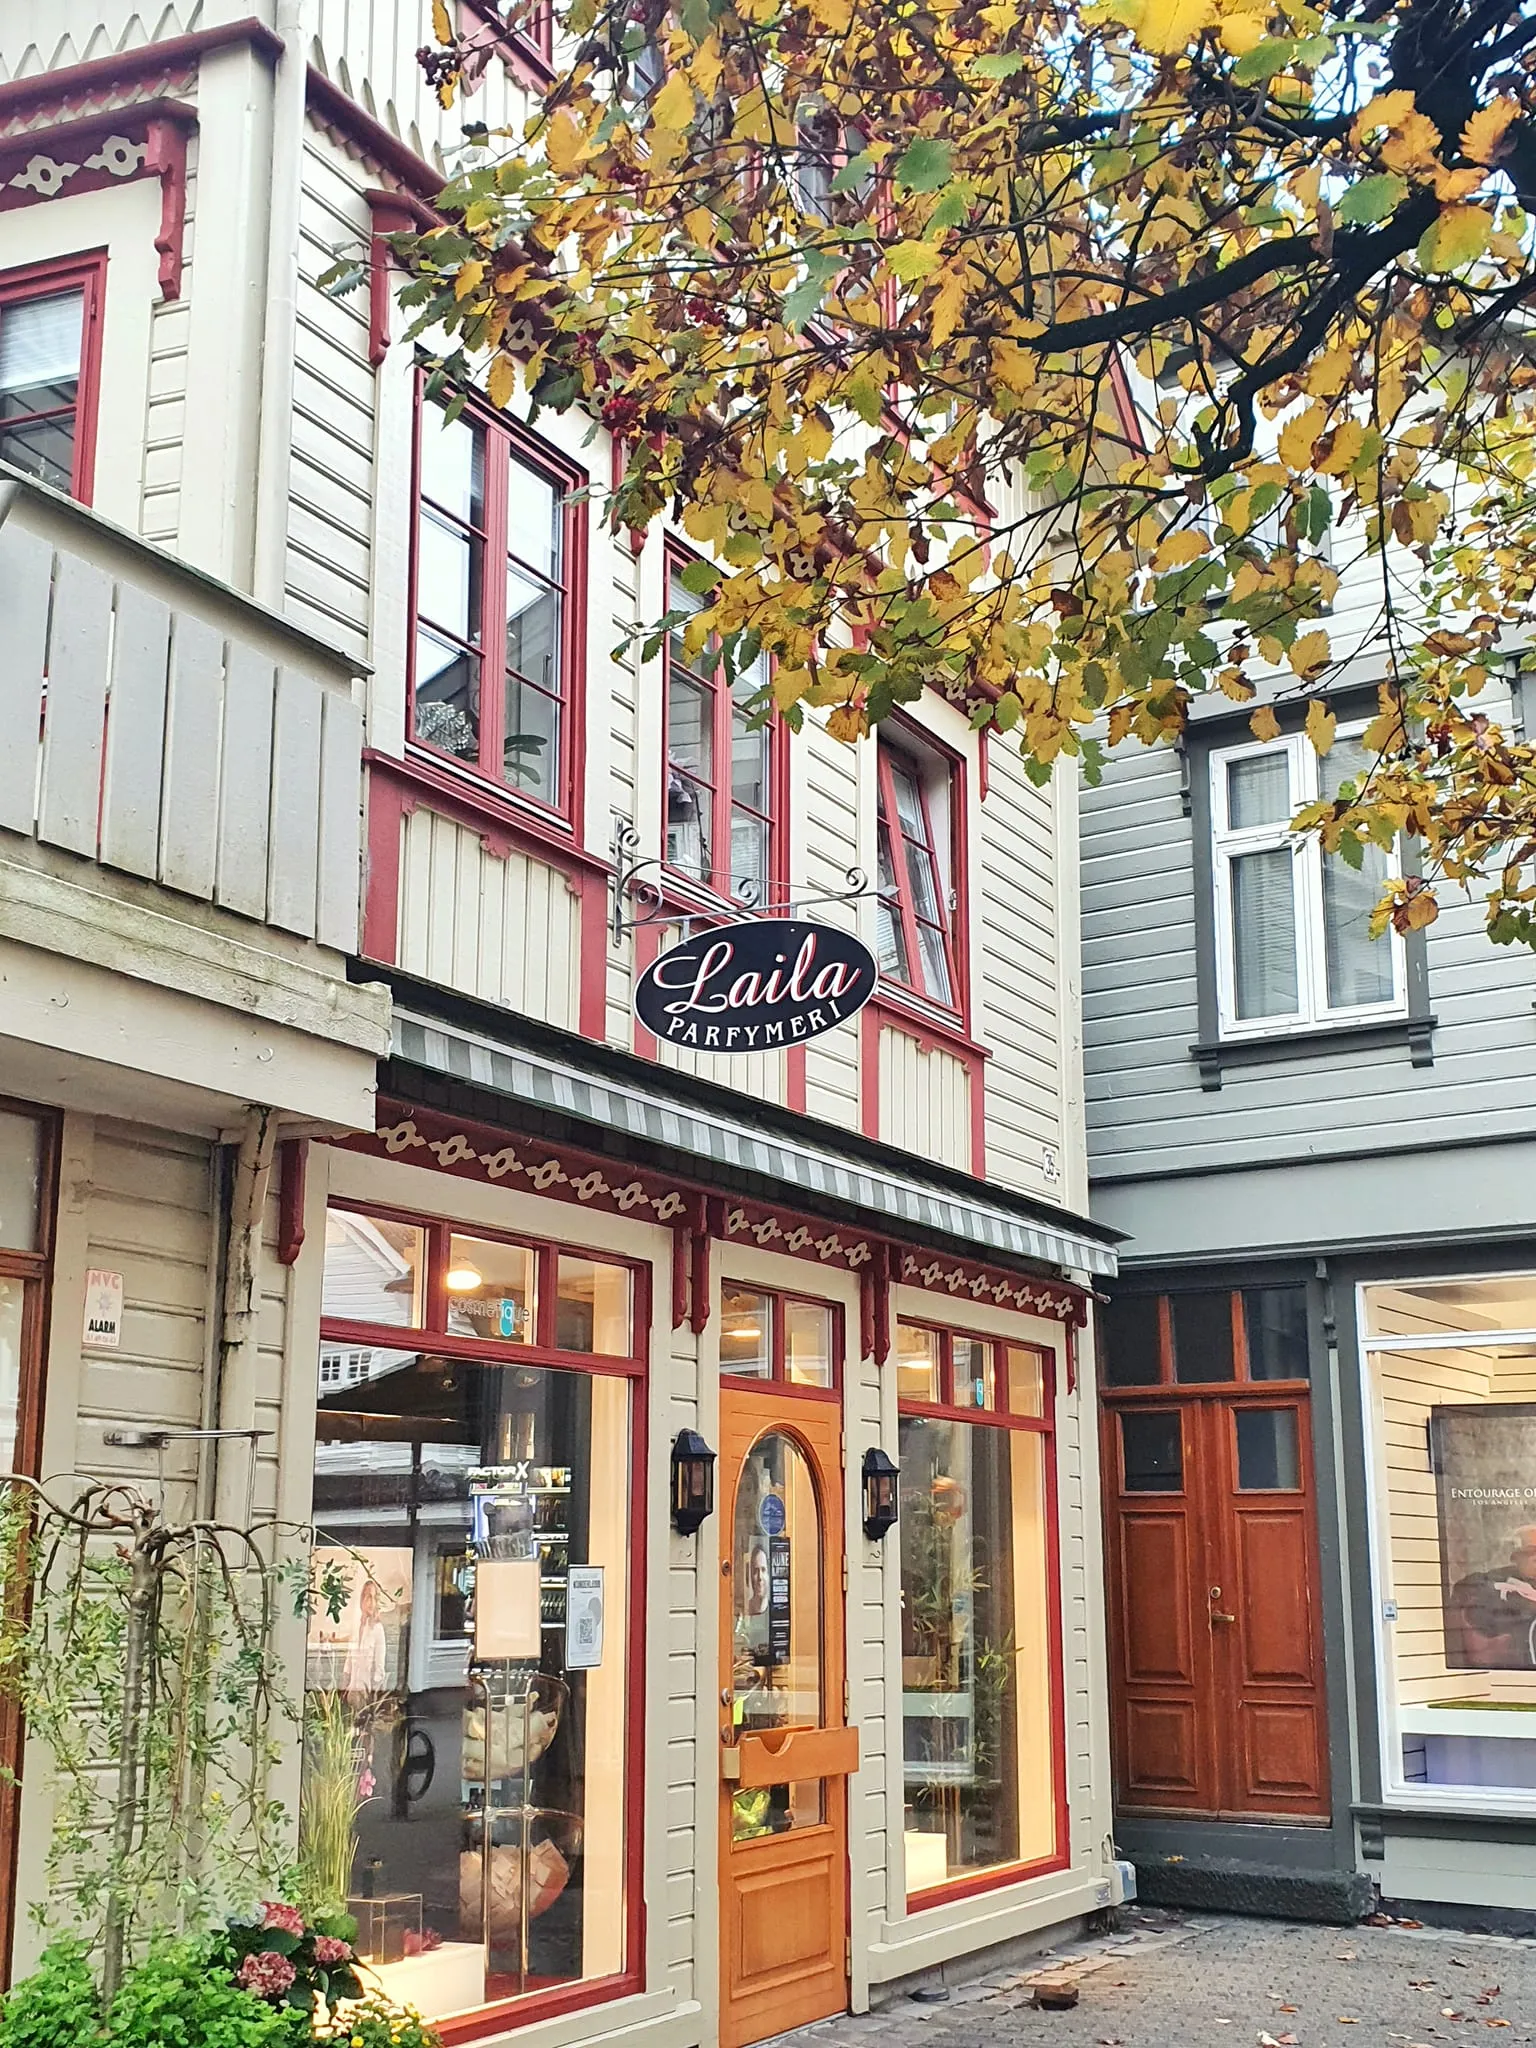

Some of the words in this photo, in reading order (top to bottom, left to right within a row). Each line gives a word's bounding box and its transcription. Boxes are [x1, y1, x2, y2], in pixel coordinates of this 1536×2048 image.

[653, 932, 862, 1014] Laila
[666, 1000, 842, 1047] PARFYMERI
[88, 1318, 116, 1334] ALARM
[1451, 1487, 1520, 1499] ENTOURAGE
